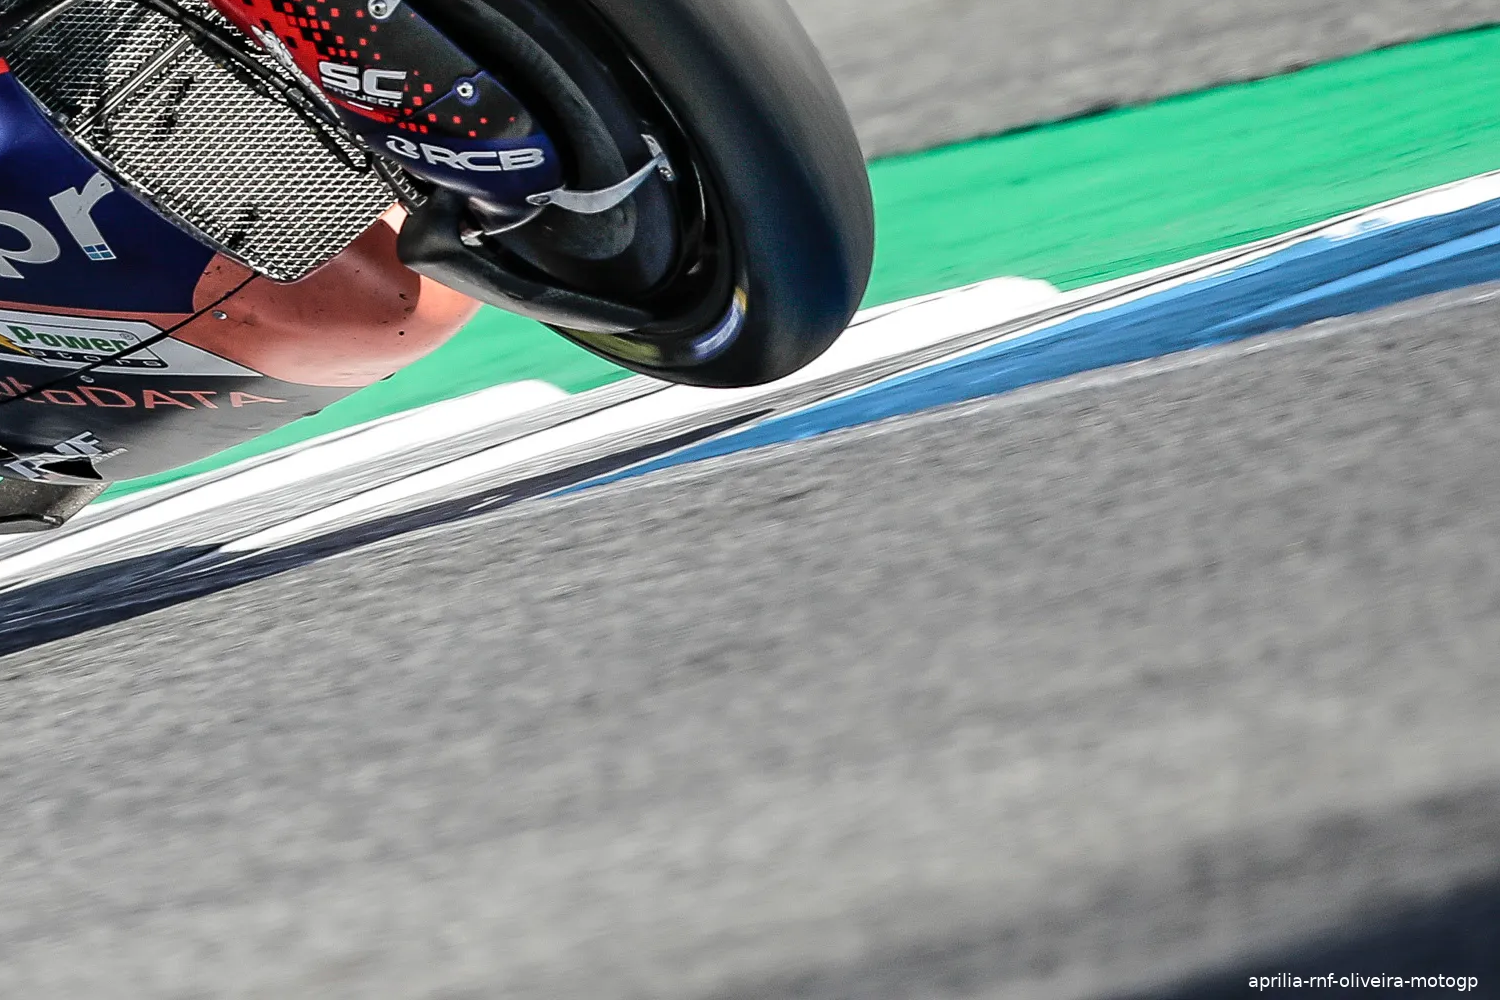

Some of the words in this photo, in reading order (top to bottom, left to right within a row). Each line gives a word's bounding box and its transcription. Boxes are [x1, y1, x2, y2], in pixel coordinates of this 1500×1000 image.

[318, 61, 408, 100] SC
[322, 82, 403, 108] PROJECT
[419, 142, 546, 172] RCB
[7, 324, 132, 354] Power
